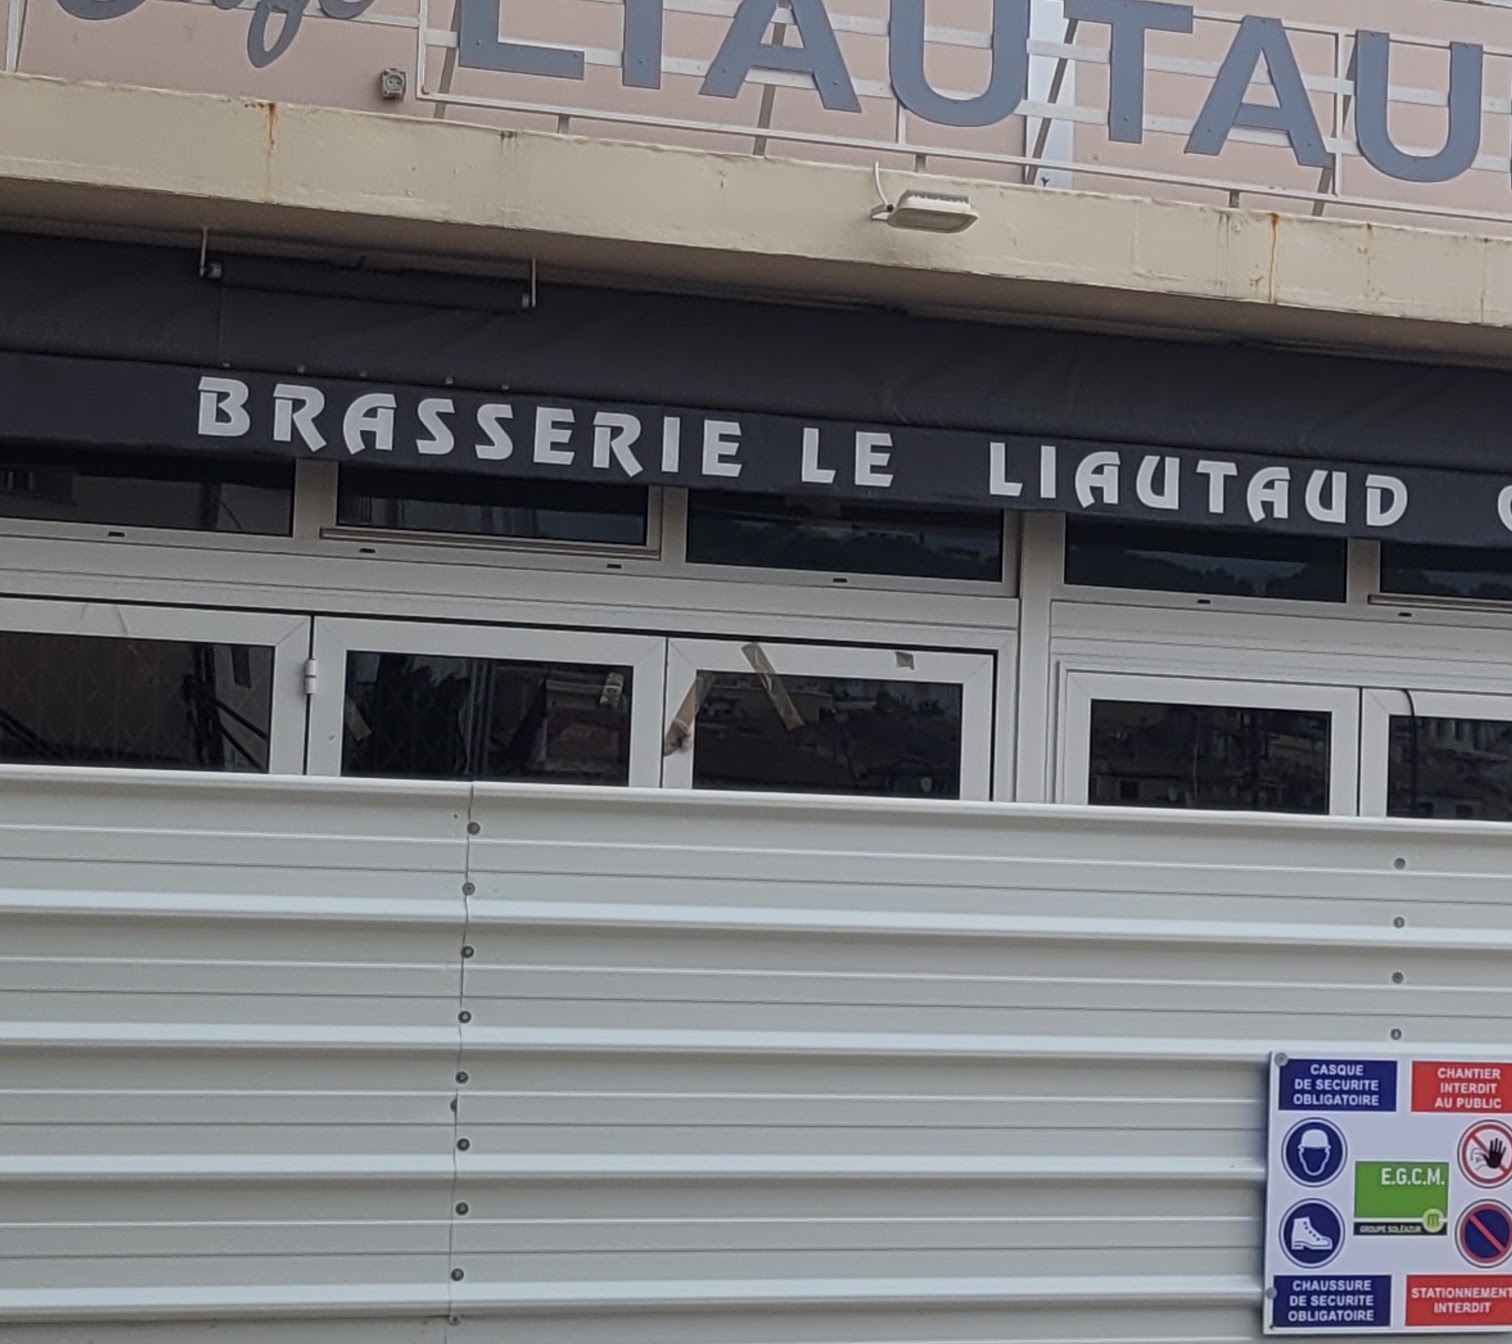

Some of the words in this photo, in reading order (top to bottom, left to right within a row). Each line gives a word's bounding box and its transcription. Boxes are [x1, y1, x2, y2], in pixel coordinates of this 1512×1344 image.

[198, 376, 743, 478] BRASSERIE
[801, 427, 894, 487] LE
[989, 442, 1409, 528] LIAUTAUD
[1310, 1064, 1364, 1076] CASQUE
[1437, 1067, 1501, 1079] CHANTIER
[1294, 1079, 1313, 1091] DE
[1315, 1079, 1379, 1091] SECURITE
[1440, 1083, 1498, 1094] INTERDIT
[1293, 1094, 1379, 1106] OBLIGATOIRE
[1435, 1097, 1452, 1108] AU
[1456, 1097, 1502, 1109] PUBLIC
[1381, 1167, 1445, 1186] E.G.C.M.
[1292, 1280, 1372, 1292] CHAUSSURE
[1289, 1295, 1307, 1307] DE
[1310, 1294, 1374, 1306] SECURITE
[1434, 1302, 1491, 1313] INTERDIT
[1288, 1310, 1375, 1322] OBLIGATOIRE
